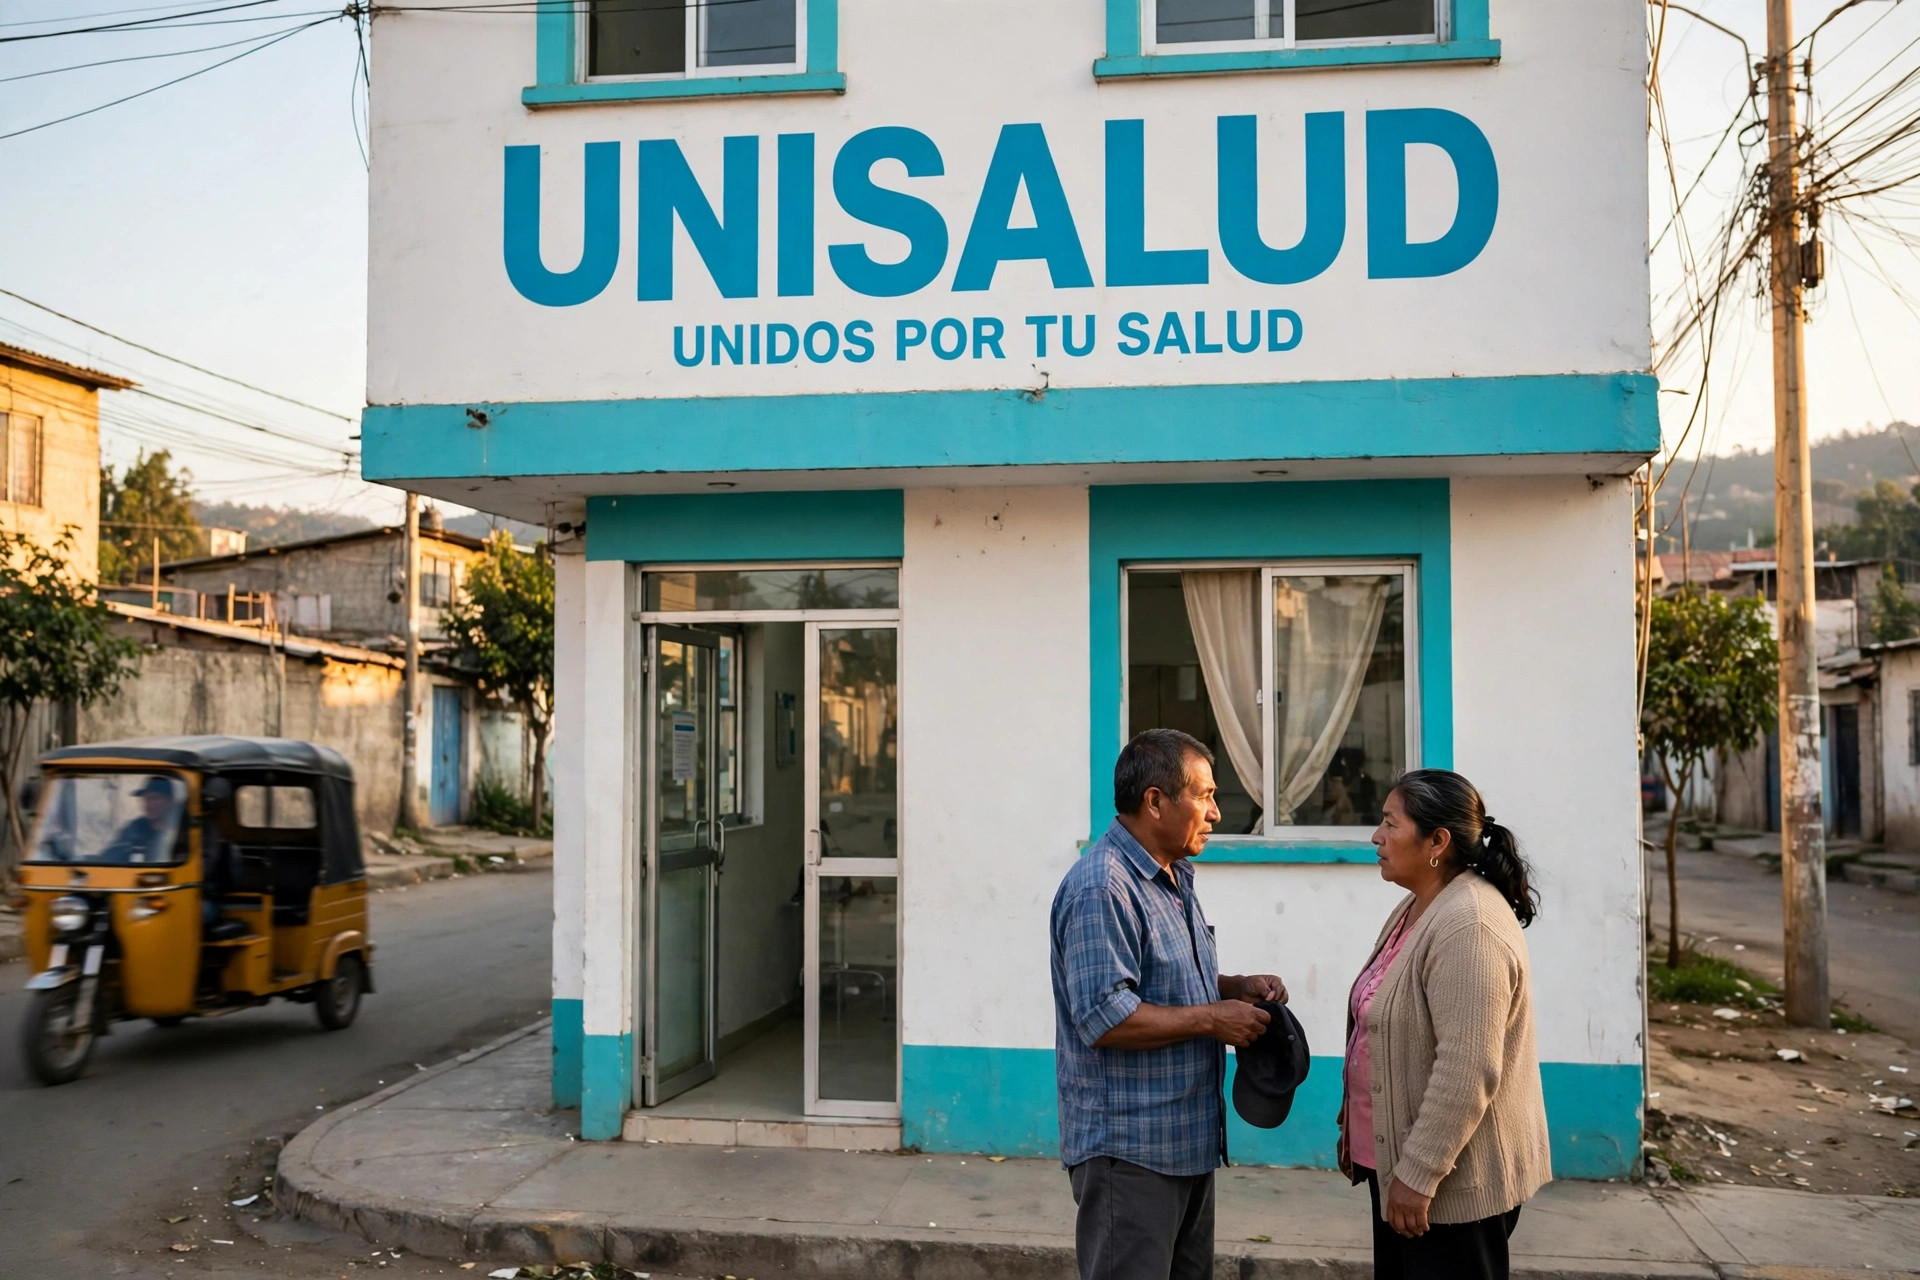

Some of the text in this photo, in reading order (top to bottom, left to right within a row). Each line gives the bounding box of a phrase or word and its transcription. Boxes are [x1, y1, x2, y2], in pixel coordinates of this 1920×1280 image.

[503, 106, 1499, 308] UNISALUD
[673, 309, 1303, 368] UNIDOS POR TU SALUD
